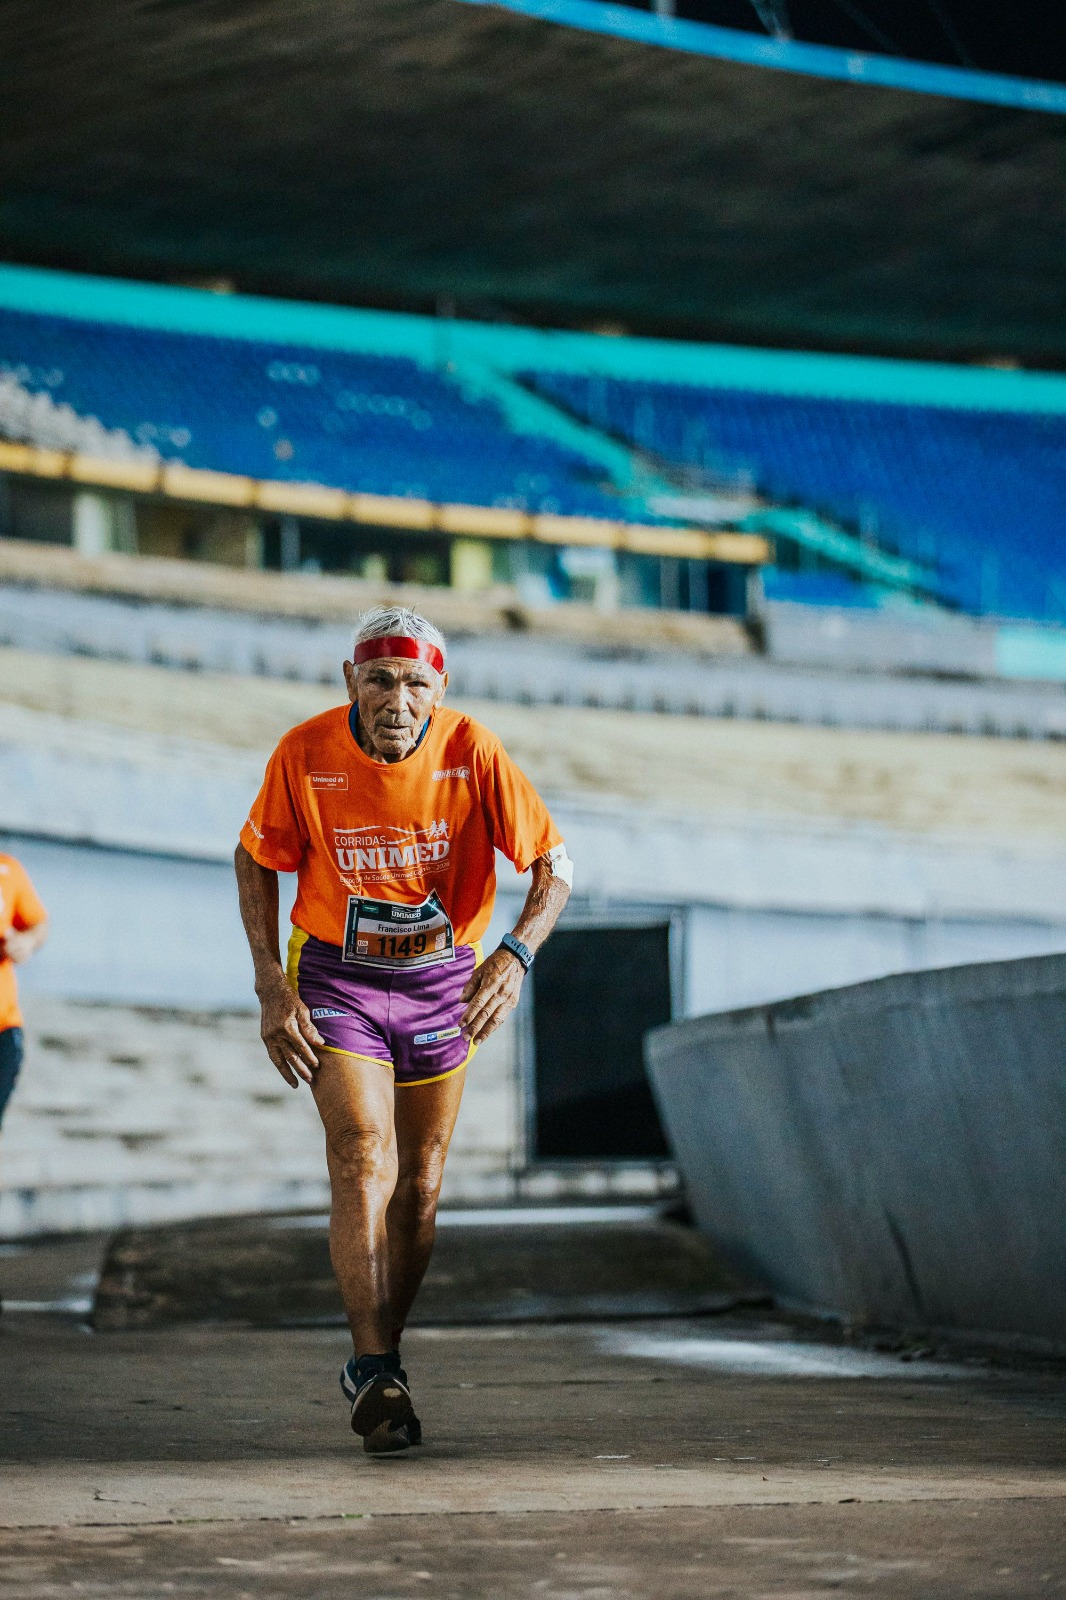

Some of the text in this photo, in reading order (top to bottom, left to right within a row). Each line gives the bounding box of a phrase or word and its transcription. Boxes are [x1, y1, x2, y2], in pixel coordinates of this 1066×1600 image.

[334, 836, 386, 847] CORRIDAS
[336, 840, 450, 871] UNIMED
[391, 910, 421, 919] UNIMED
[378, 923, 430, 933] Francisco Lima
[377, 933, 427, 957] 1149
